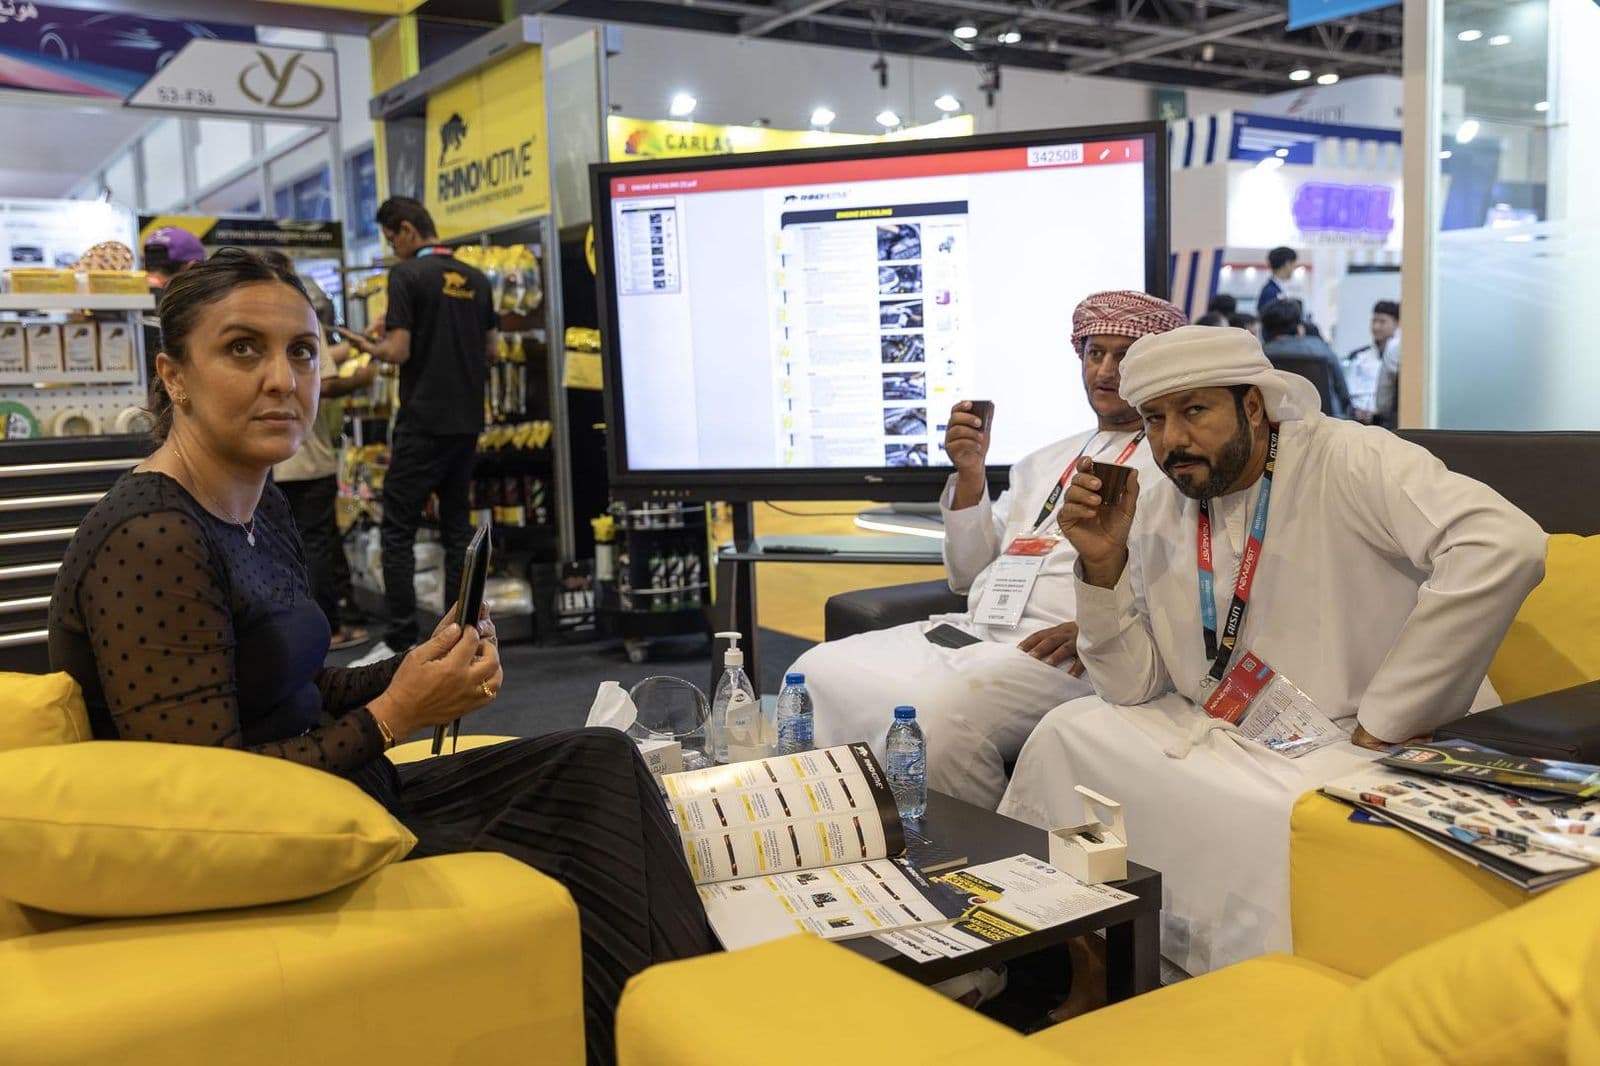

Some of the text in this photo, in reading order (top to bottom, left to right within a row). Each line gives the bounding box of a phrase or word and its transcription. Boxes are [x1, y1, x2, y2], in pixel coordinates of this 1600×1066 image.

[438, 140, 532, 202] RHINOMOTIVE
[1032, 150, 1079, 163] 342508
[1239, 547, 1256, 591] NEWEAST
[1227, 605, 1241, 636] AISIN
